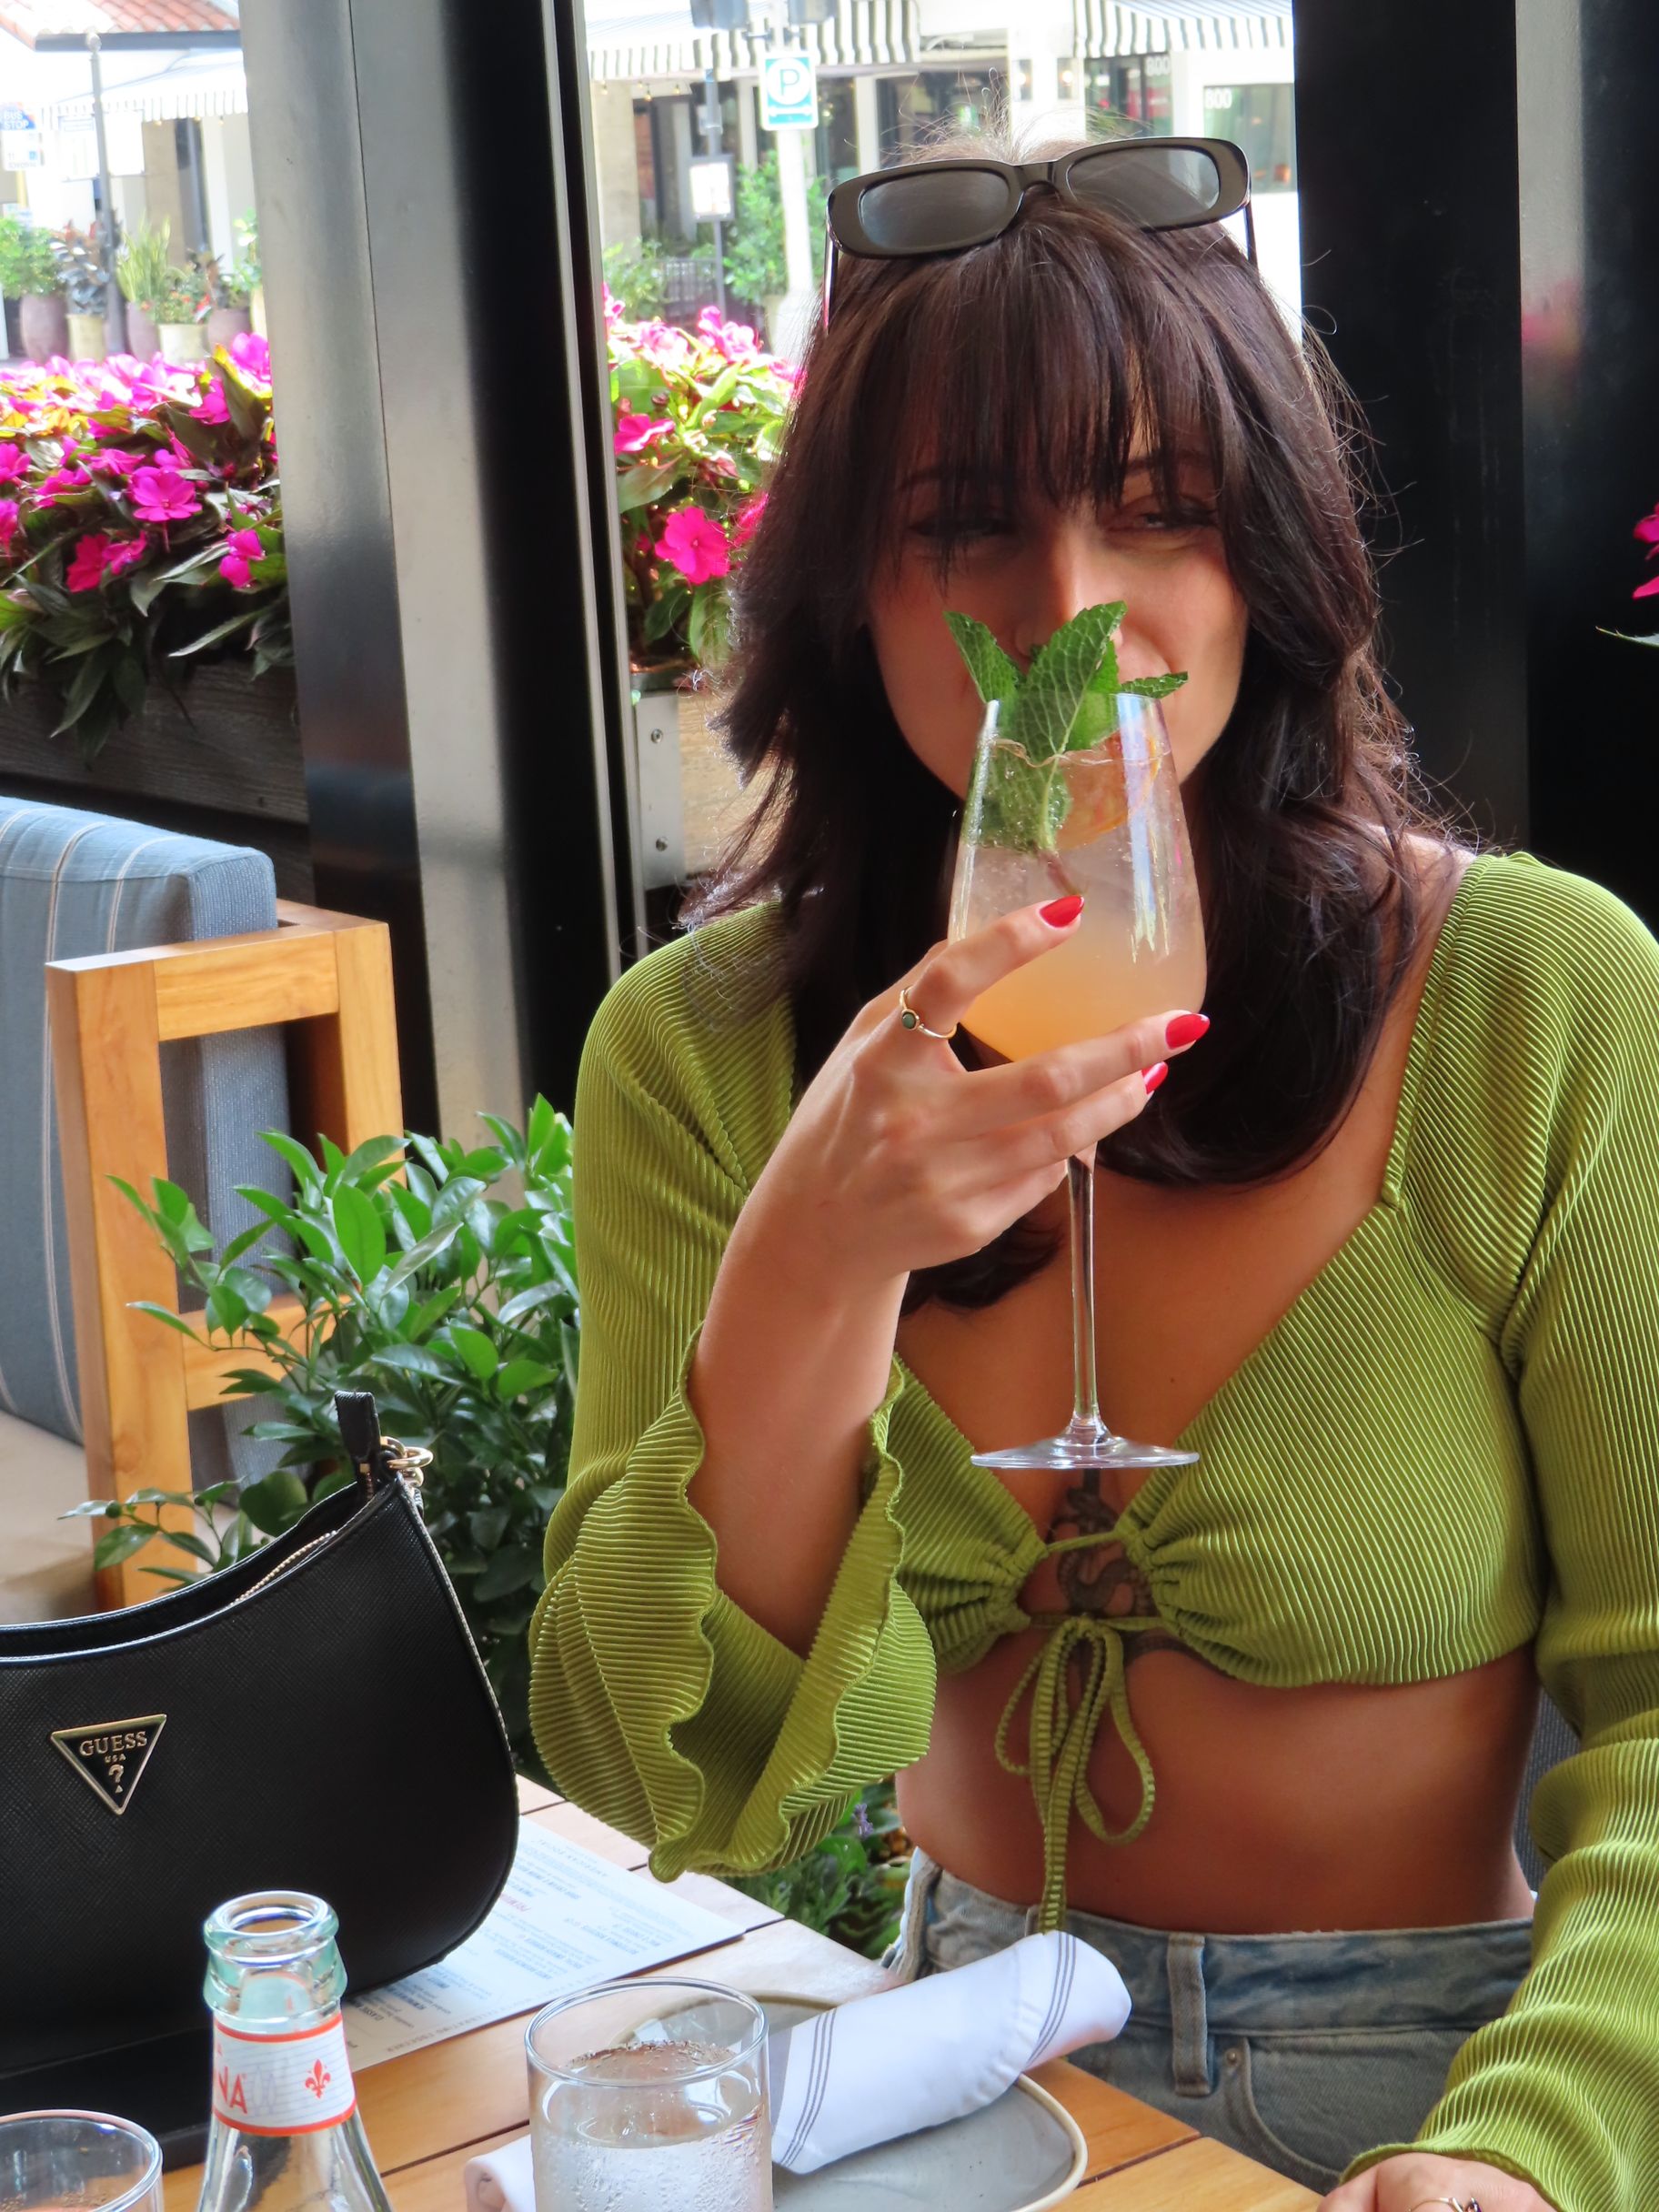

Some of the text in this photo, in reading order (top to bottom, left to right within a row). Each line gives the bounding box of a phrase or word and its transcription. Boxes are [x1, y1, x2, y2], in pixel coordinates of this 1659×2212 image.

[1146, 56, 1171, 76] 800
[779, 68, 800, 96] P
[1204, 88, 1232, 109] 800
[4, 110, 24, 120] BUS
[5, 120, 30, 130] STOP
[79, 1731, 147, 1756] GUESS
[104, 1753, 126, 1764] USA
